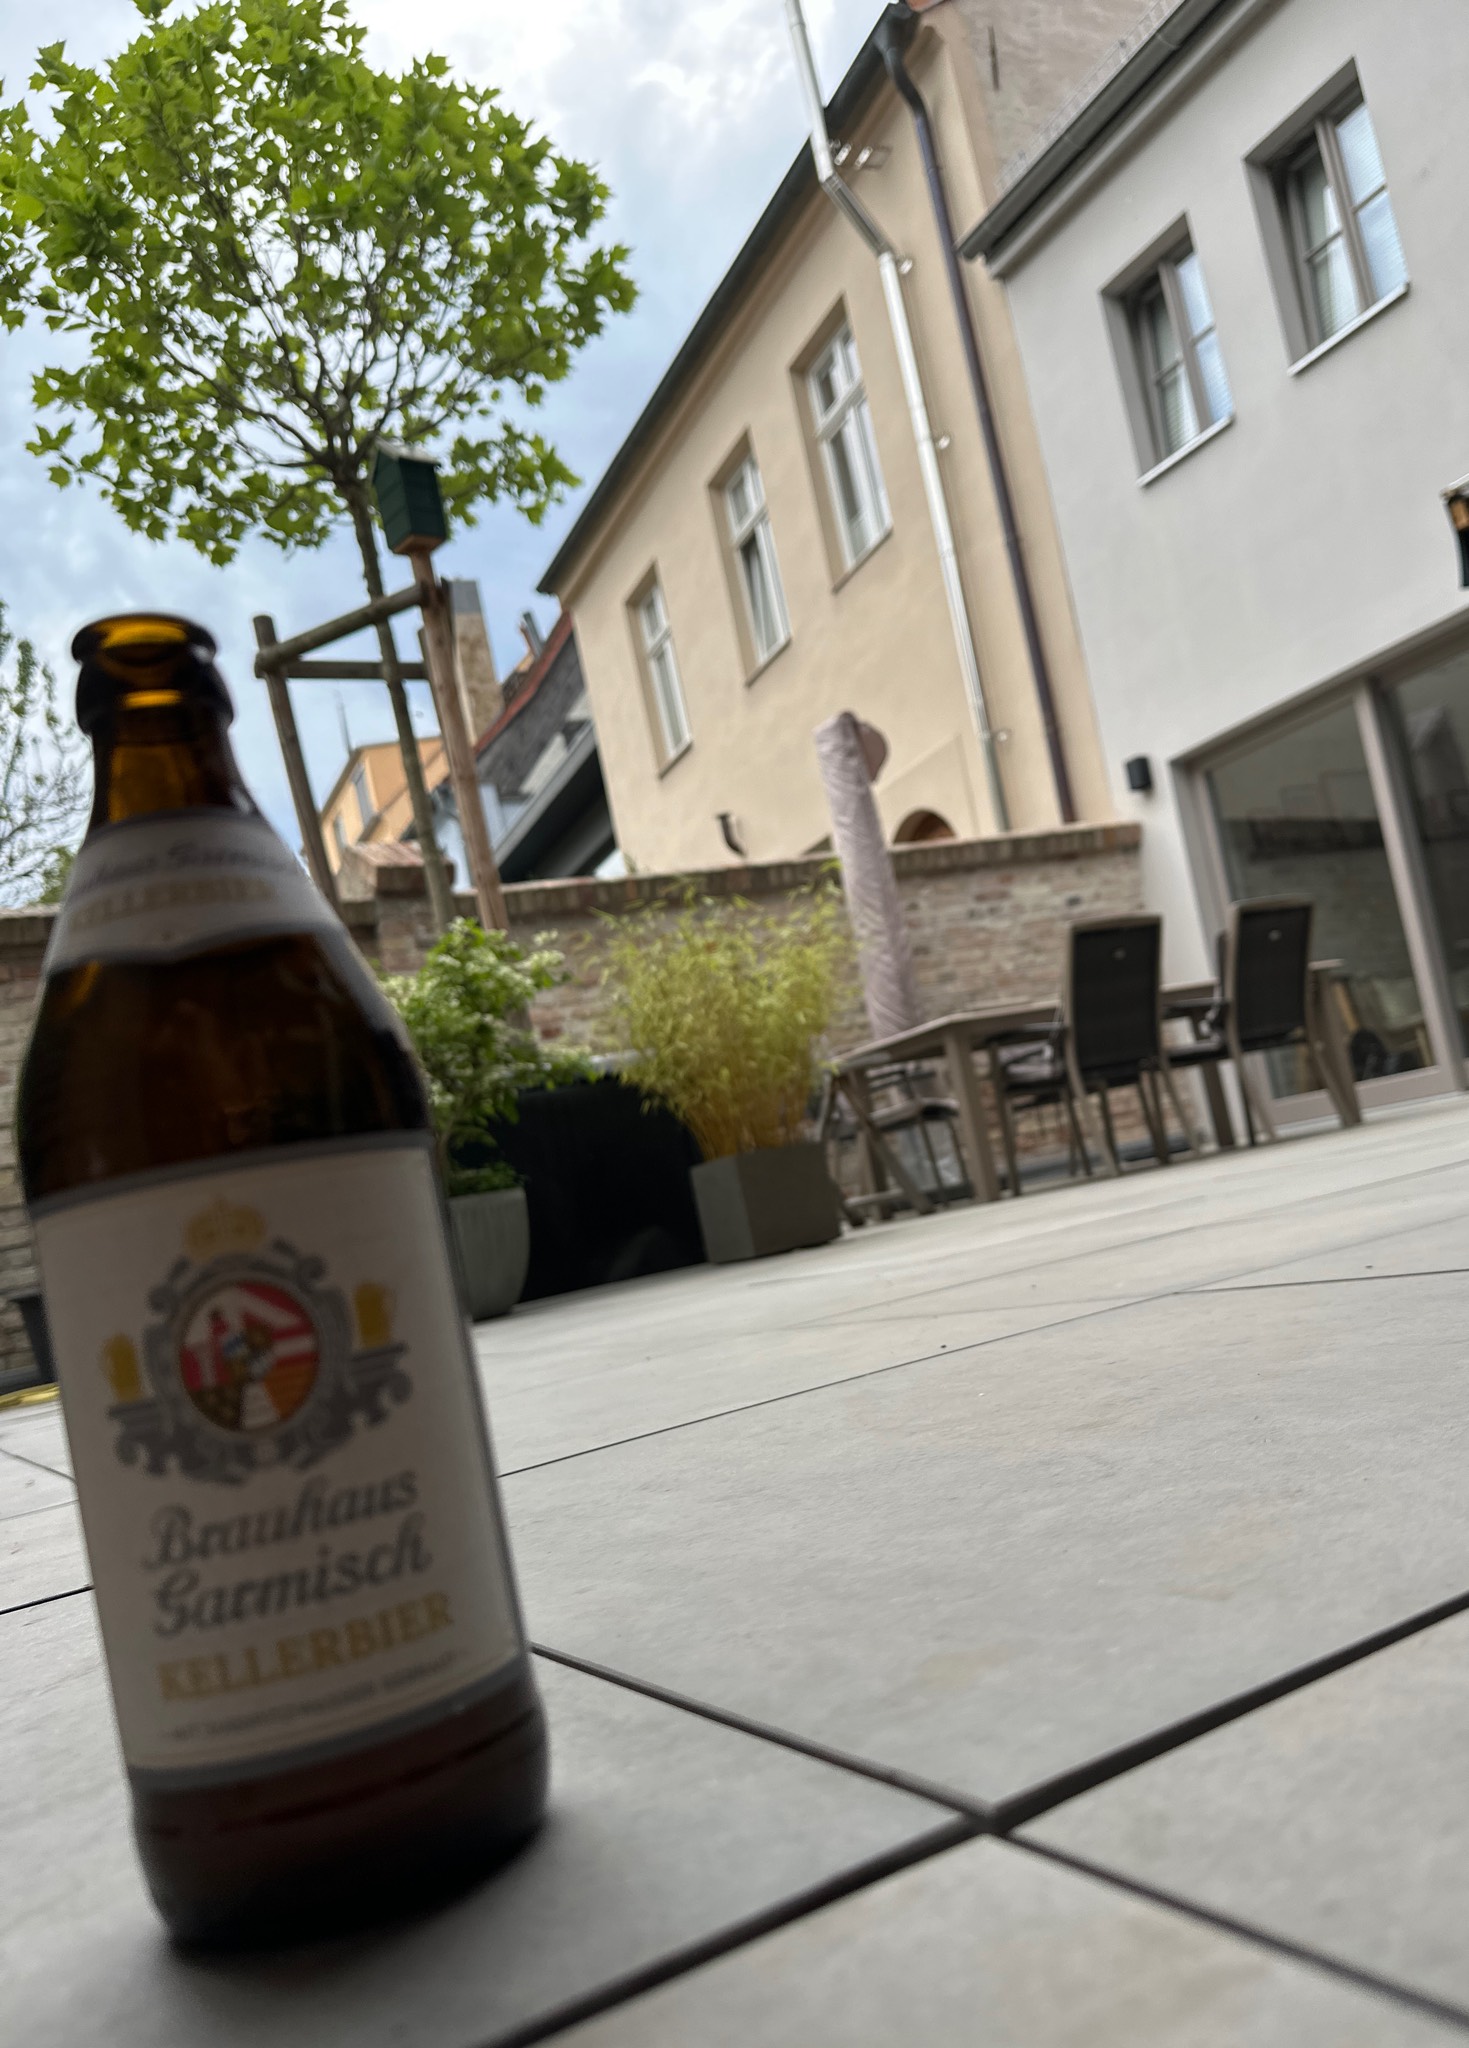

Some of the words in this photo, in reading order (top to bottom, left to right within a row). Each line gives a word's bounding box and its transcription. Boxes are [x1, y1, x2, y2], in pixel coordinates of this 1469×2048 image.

[142, 1469, 418, 1572] Brauhaus
[154, 1511, 434, 1639] Garmisch
[157, 1591, 454, 1700] KELLERBIER
